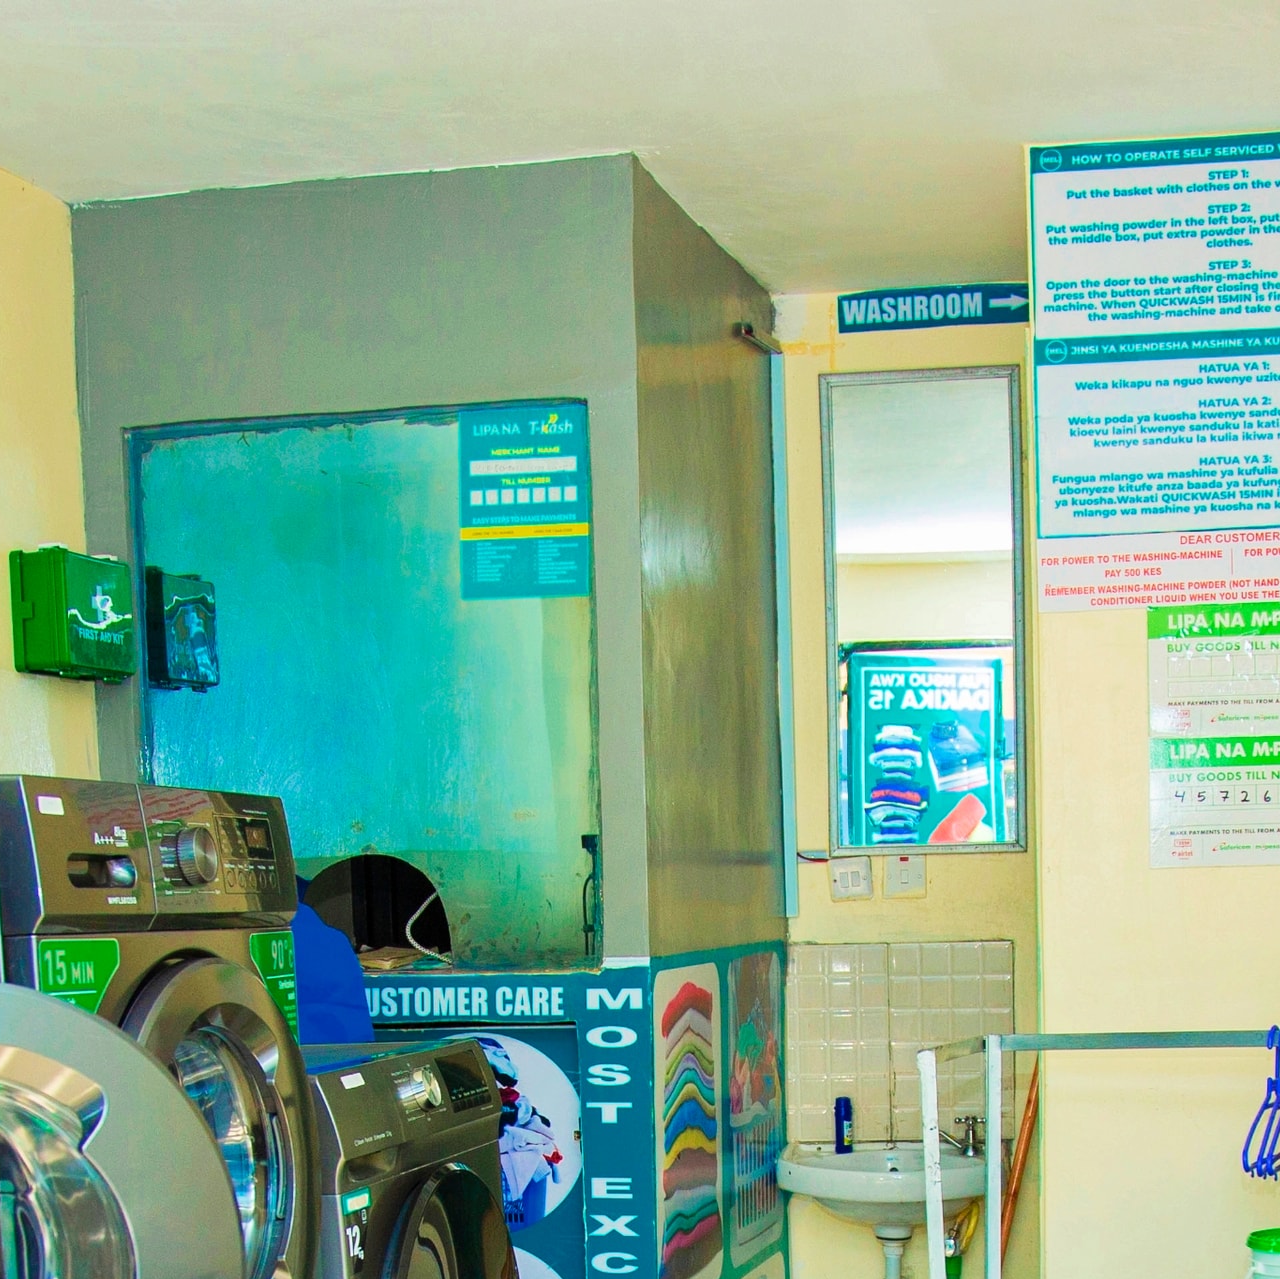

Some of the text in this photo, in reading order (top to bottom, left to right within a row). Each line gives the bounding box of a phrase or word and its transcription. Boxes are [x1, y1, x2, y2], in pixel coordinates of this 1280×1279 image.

[1071, 154, 1101, 164] HOW
[1106, 153, 1120, 162] TO
[1125, 149, 1179, 161] OPERATE
[1184, 148, 1212, 158] SELF
[1215, 144, 1274, 156] SERVICED
[1208, 169, 1249, 180] STEP 1:
[1066, 189, 1087, 199] Put
[1089, 188, 1110, 198] the
[1113, 186, 1152, 196] basket
[1155, 184, 1183, 194] with
[1185, 181, 1230, 192] clothes
[1232, 182, 1248, 190] on
[1250, 179, 1272, 189] the
[1207, 203, 1250, 214] STEP 2:
[1045, 225, 1066, 234] Put
[1069, 222, 1119, 234] washing
[1122, 219, 1167, 232] powder
[1170, 218, 1182, 227] in
[1184, 217, 1205, 226] the
[1207, 216, 1228, 225] left
[1231, 214, 1256, 225] box,
[1259, 213, 1280, 224] put
[842, 292, 983, 325] WASHROOM
[1071, 345, 1098, 354] JINSI
[1119, 341, 1188, 352] KUENDESHA
[1192, 338, 1242, 349] MASHINE
[1198, 361, 1269, 373] HATUA YA 1:
[1075, 380, 1108, 390] Weka
[1111, 378, 1152, 390] kikapu
[1172, 378, 1203, 387] nguo
[1206, 373, 1252, 386] kwenye
[473, 424, 499, 437] LIPA
[501, 423, 521, 435] NA
[1179, 534, 1211, 545] DEAR
[1041, 550, 1222, 566] FOR POWER TO THE WASHING-MACHINE
[1104, 567, 1161, 578] PAY 500 KES
[1168, 613, 1208, 630] LIPA
[1214, 612, 1245, 628] NA
[79, 627, 98, 641] FIRST
[1167, 643, 1191, 653] BUY
[1195, 641, 1241, 652] GOODS
[1245, 640, 1266, 651] ILL
[1170, 743, 1210, 760] LIPA
[1216, 742, 1246, 758] NA
[1169, 773, 1192, 783] BUY
[1197, 771, 1242, 782] GOODS
[1246, 771, 1267, 780] TILL
[44, 949, 95, 985] 15 MIN
[495, 986, 565, 1017] CARE
[586, 987, 643, 1124] MOST
